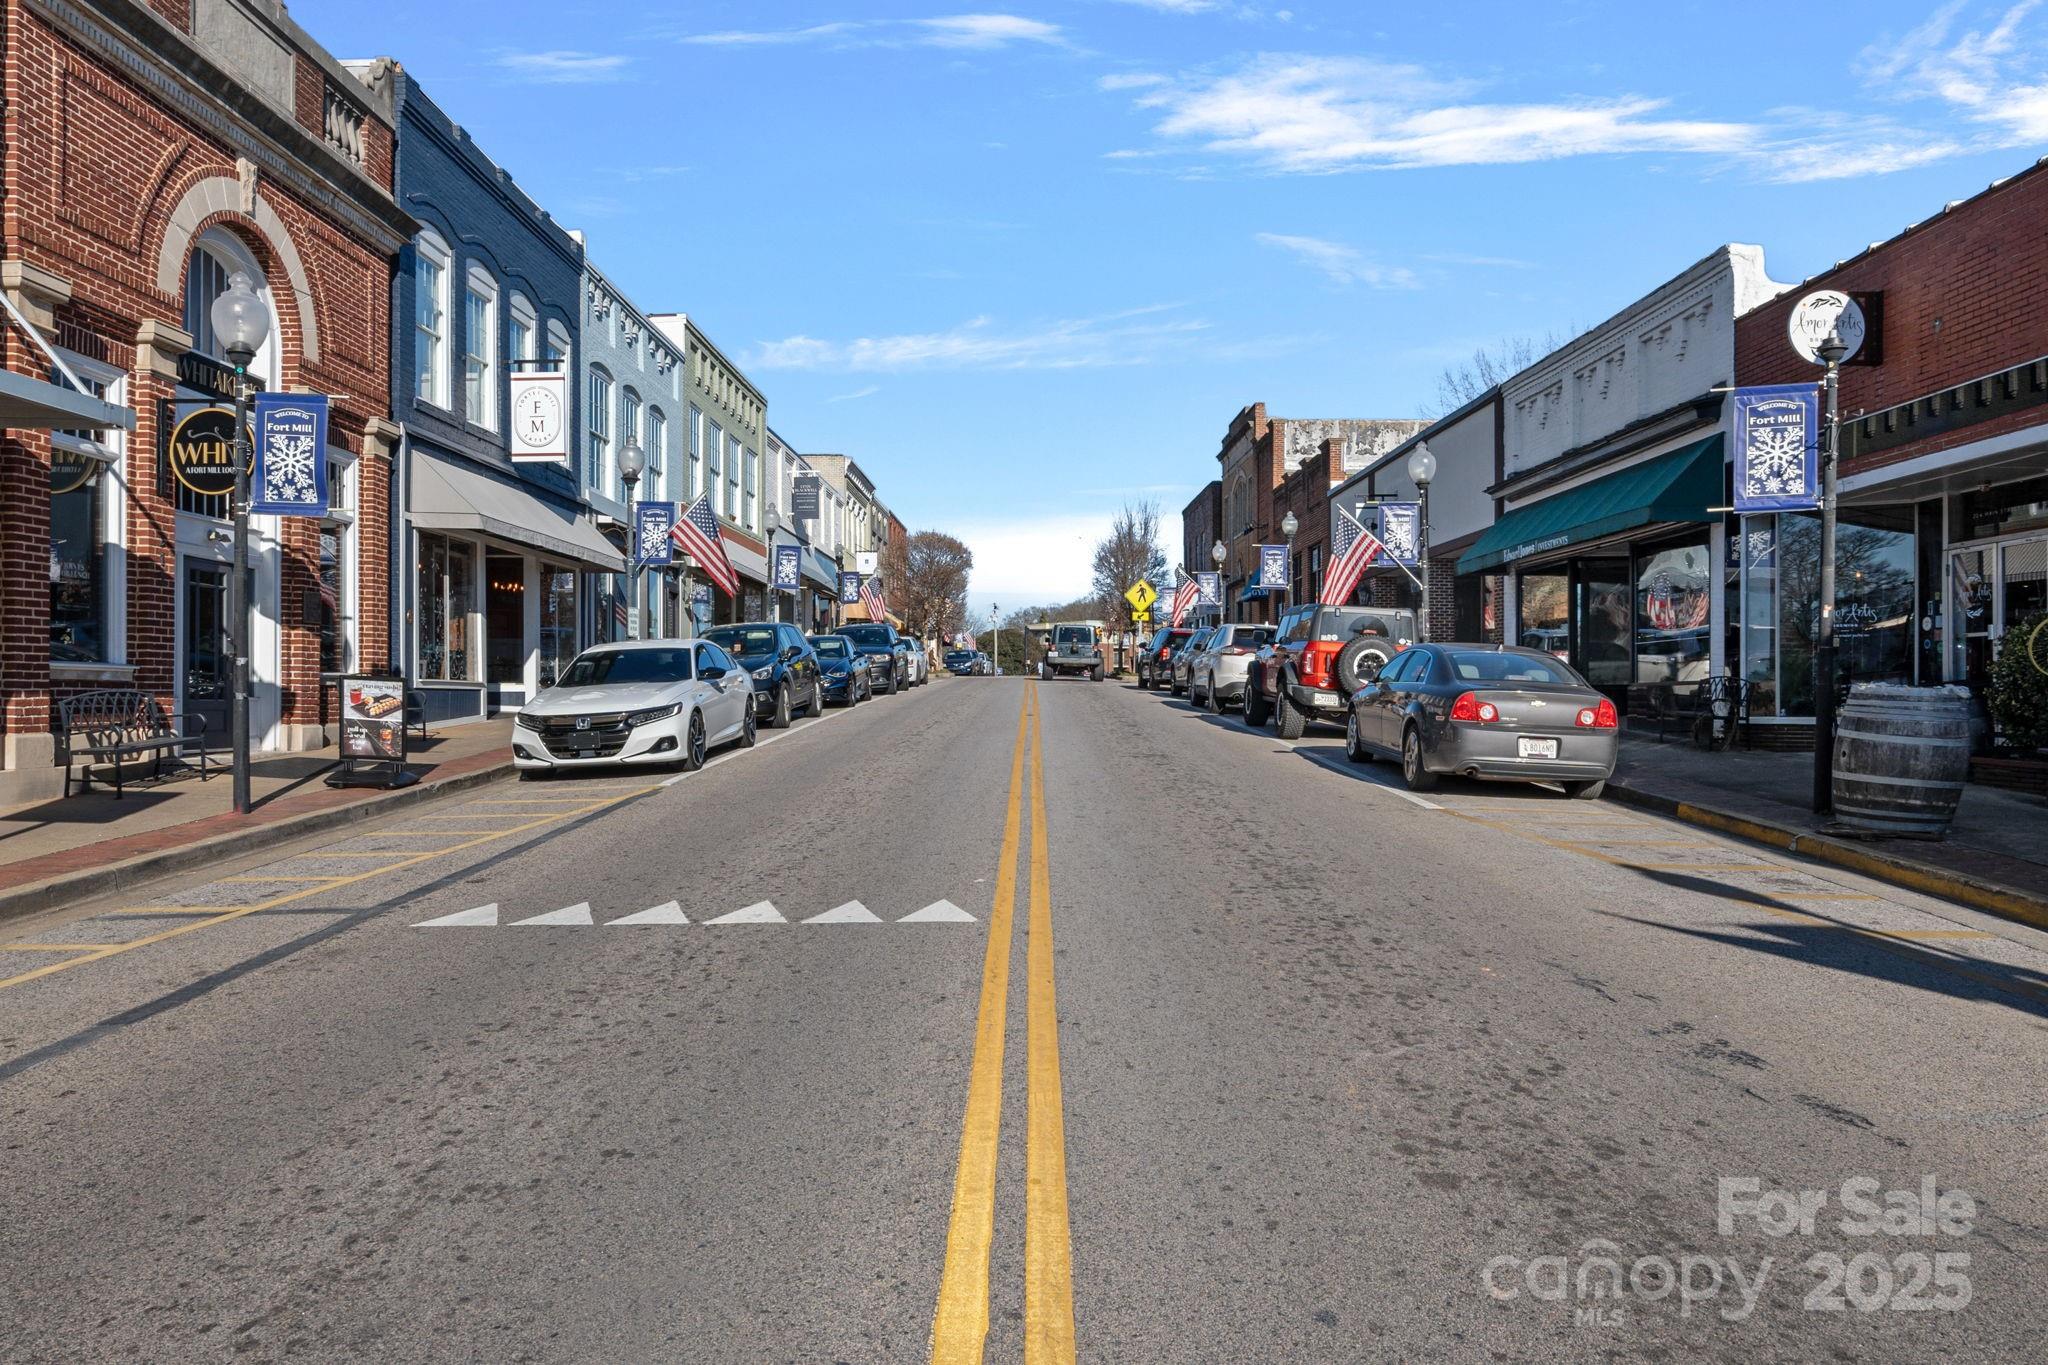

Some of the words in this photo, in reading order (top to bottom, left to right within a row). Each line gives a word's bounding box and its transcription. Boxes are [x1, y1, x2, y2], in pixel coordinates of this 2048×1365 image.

[534, 401, 541, 413] F
[1757, 402, 1787, 411] WELCOME
[274, 410, 302, 418] WELCOME
[1750, 416, 1775, 425] Fort
[1777, 414, 1801, 423] Mill
[267, 422, 289, 432] Fort
[292, 423, 312, 433] Mill
[531, 420, 544, 432] M
[207, 466, 221, 474] MILL
